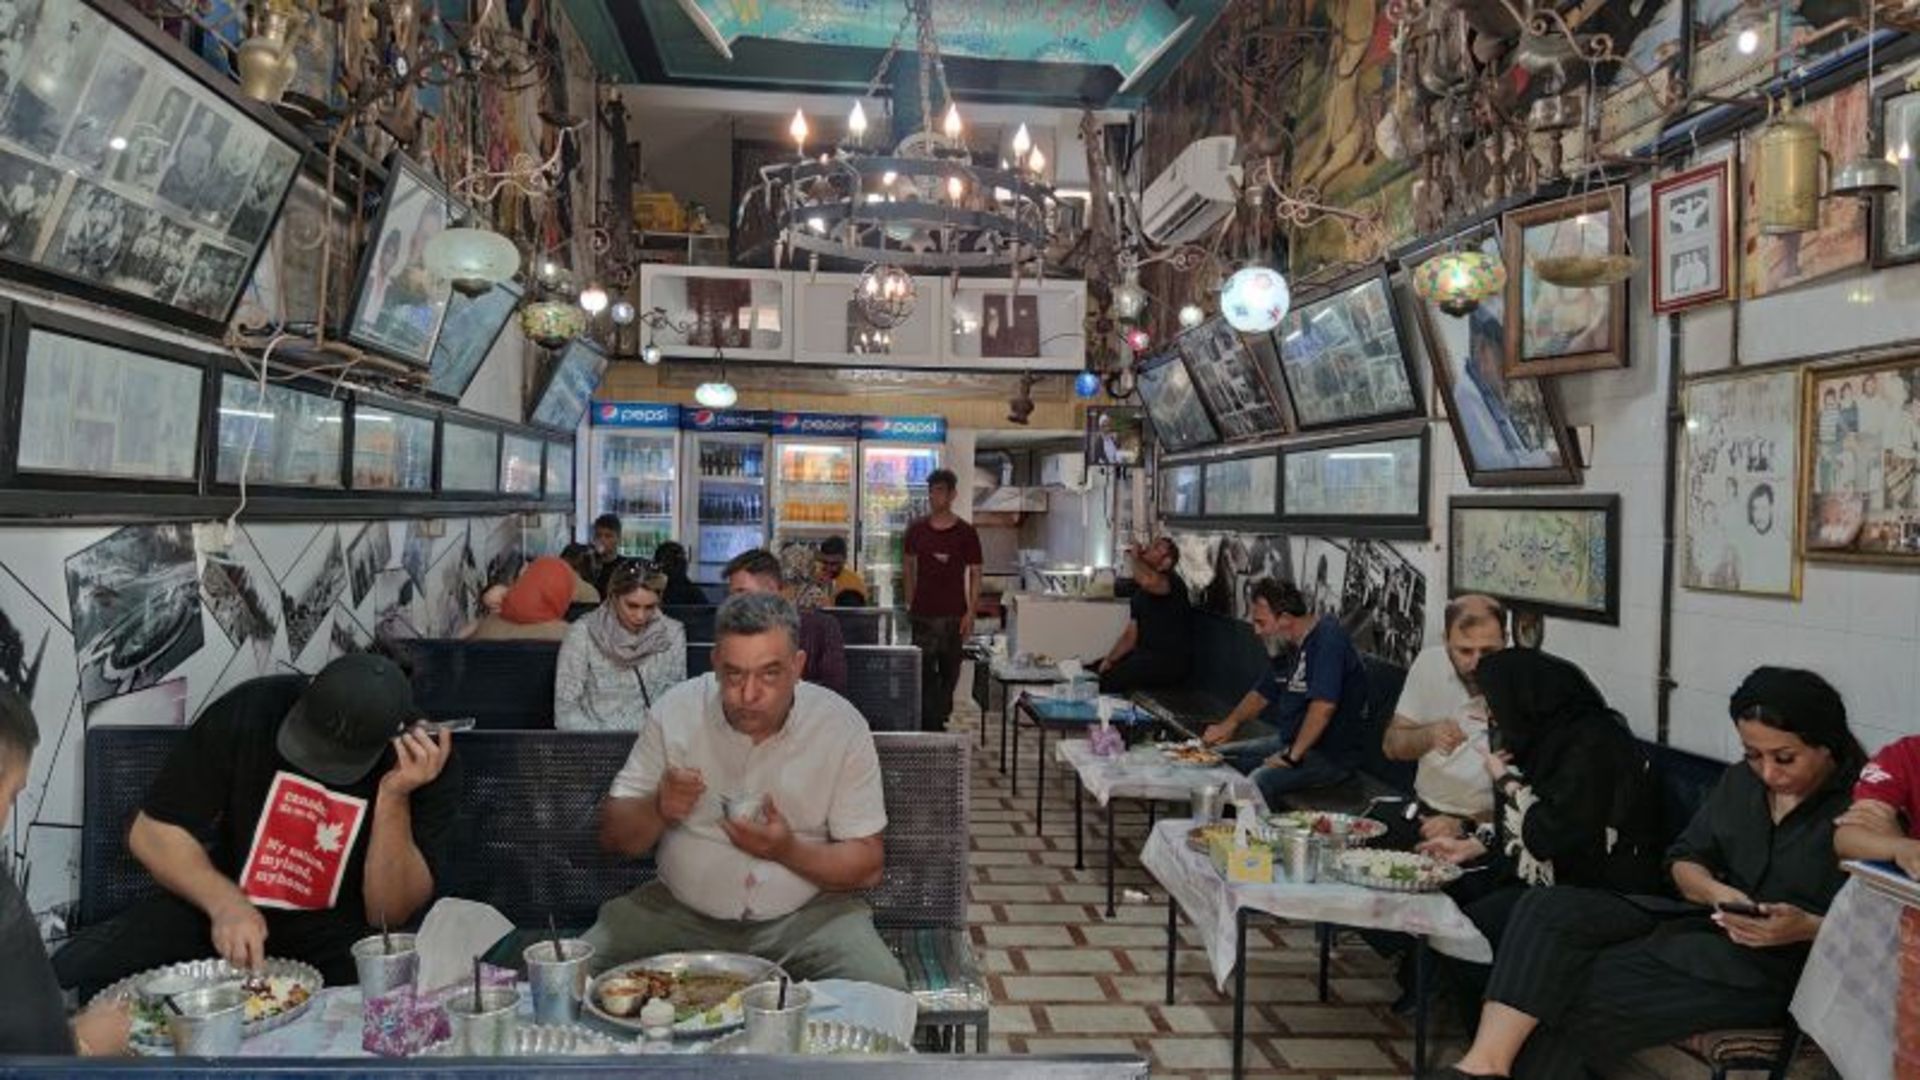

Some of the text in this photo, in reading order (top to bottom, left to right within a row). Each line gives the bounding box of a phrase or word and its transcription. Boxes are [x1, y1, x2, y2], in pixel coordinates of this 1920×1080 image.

[621, 408, 669, 422] pepsi
[801, 419, 846, 432] pepsi
[891, 421, 938, 433] pepsi
[266, 838, 286, 854] My
